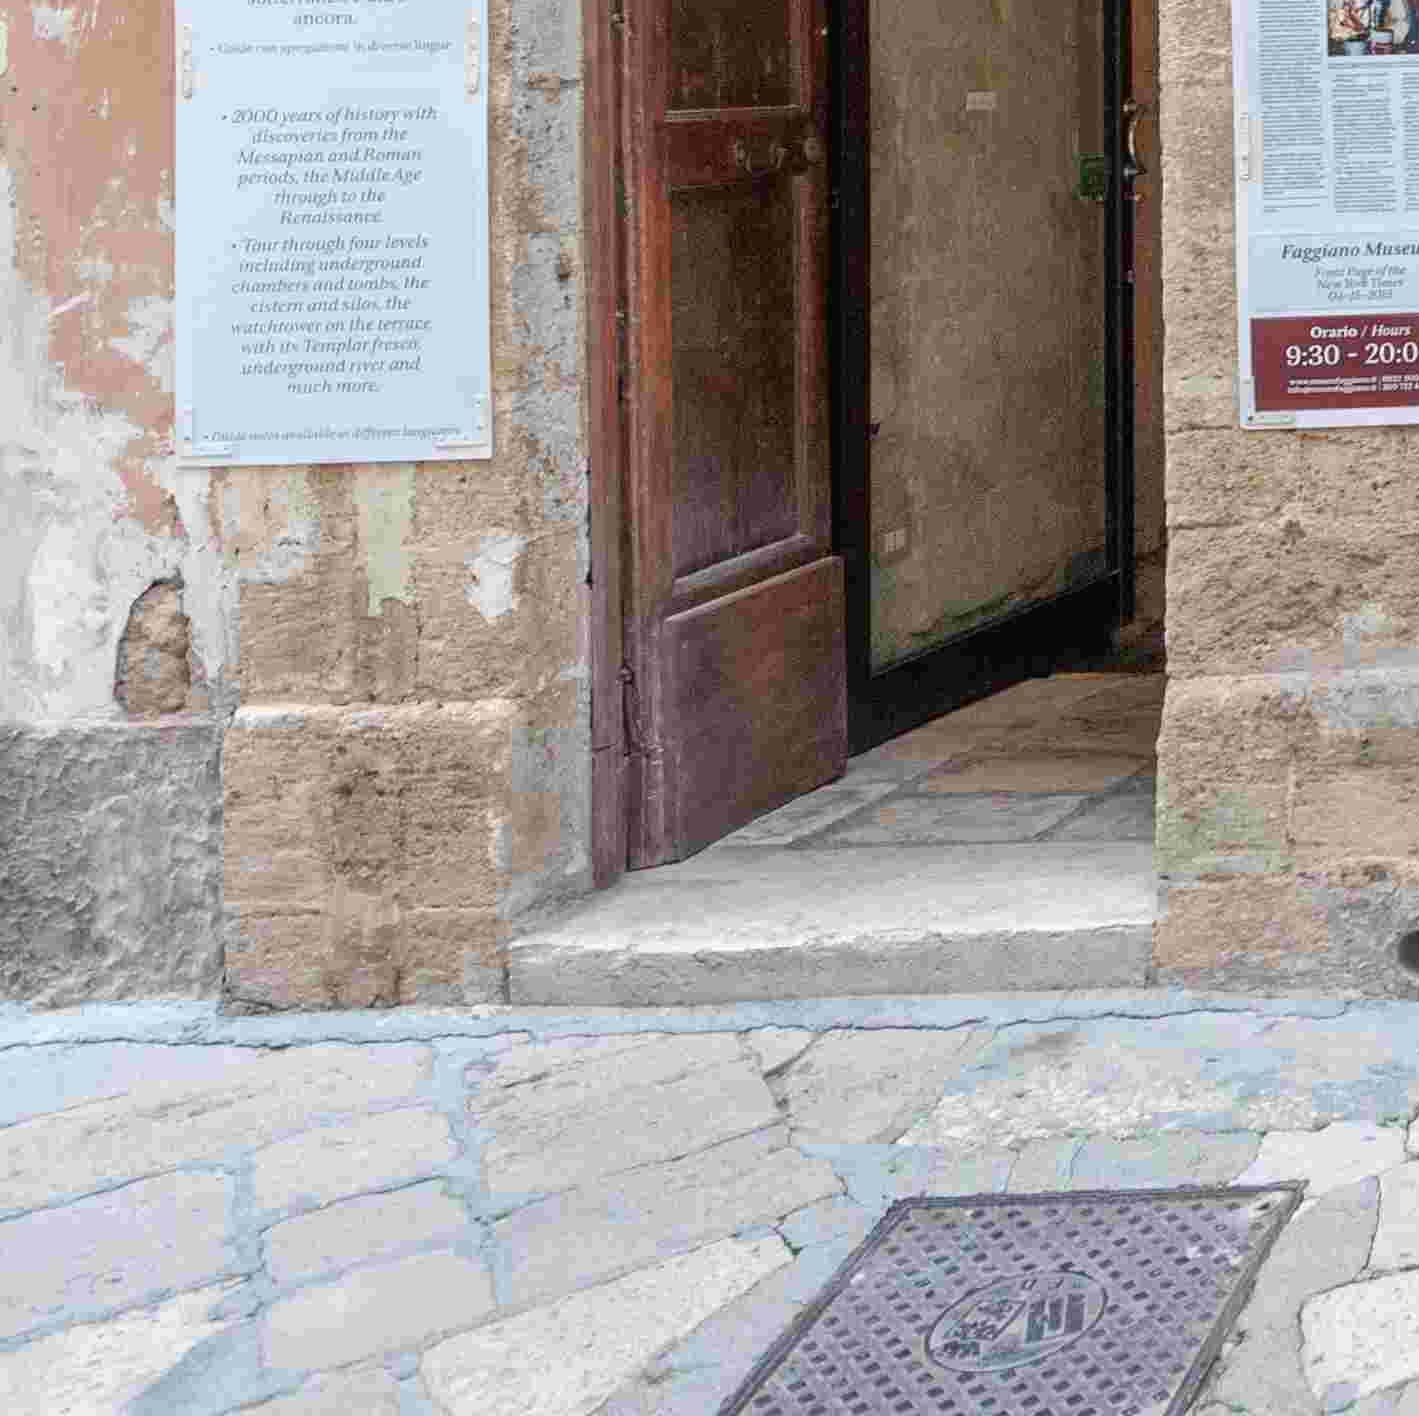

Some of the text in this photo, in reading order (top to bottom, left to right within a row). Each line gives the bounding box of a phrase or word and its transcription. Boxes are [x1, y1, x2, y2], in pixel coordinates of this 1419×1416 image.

[232, 109, 278, 123] 2000
[344, 107, 400, 125] history
[342, 127, 377, 144] from
[384, 126, 408, 141] the
[364, 147, 421, 161] Roman
[341, 190, 357, 202] to
[360, 187, 386, 202] the
[281, 236, 345, 256] through
[385, 234, 429, 249] levels
[1281, 243, 1360, 263] Faggiano
[313, 277, 344, 292] and
[1311, 325, 1358, 339] Orario
[1372, 324, 1411, 337] Hours
[1286, 344, 1340, 367] 9:30
